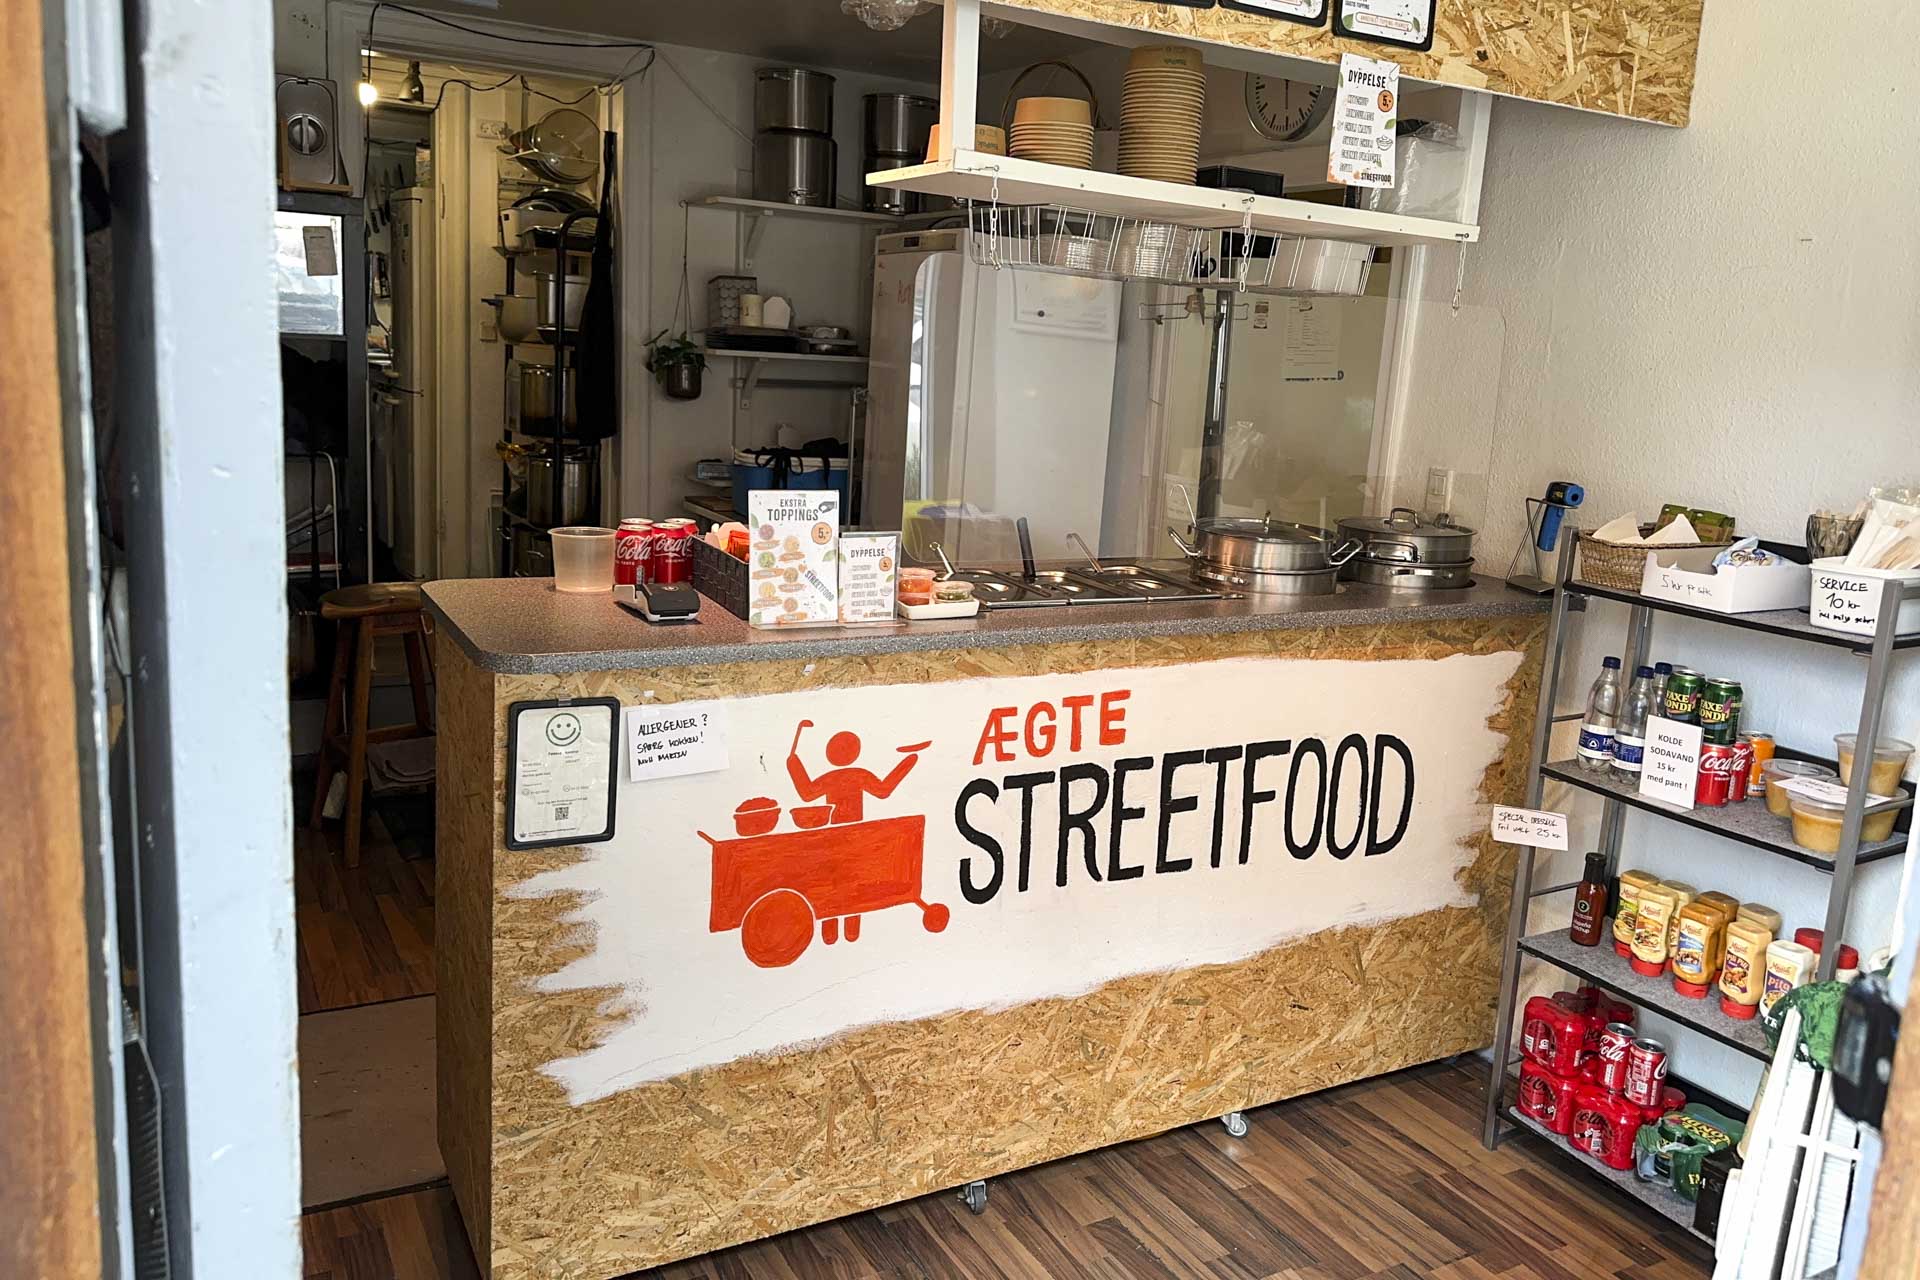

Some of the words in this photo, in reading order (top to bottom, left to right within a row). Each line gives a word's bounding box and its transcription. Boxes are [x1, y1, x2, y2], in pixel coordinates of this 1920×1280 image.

[1348, 69, 1386, 88] DYPPELSE
[780, 499, 807, 507] EKSTRA
[768, 508, 819, 521] TOPPINGS
[850, 548, 885, 558] DYPPELSE
[804, 570, 835, 602] STREETFOOD
[1819, 577, 1869, 592] SERVICE
[1826, 592, 1844, 609] 10
[1848, 600, 1861, 609] kr
[1700, 709, 1726, 722] ONDI
[637, 718, 698, 737] ALLERGENER
[973, 689, 1132, 766] ÆGTE
[1658, 733, 1684, 747] KOLDE
[1650, 745, 1695, 764] SODAVAND
[1657, 762, 1666, 770] 15
[1668, 764, 1676, 773] kr
[1699, 751, 1733, 774] Coca
[1647, 774, 1664, 783] med
[1665, 779, 1683, 789] pant
[954, 733, 1415, 905] STREETFOOD
[1536, 828, 1550, 838] 25
